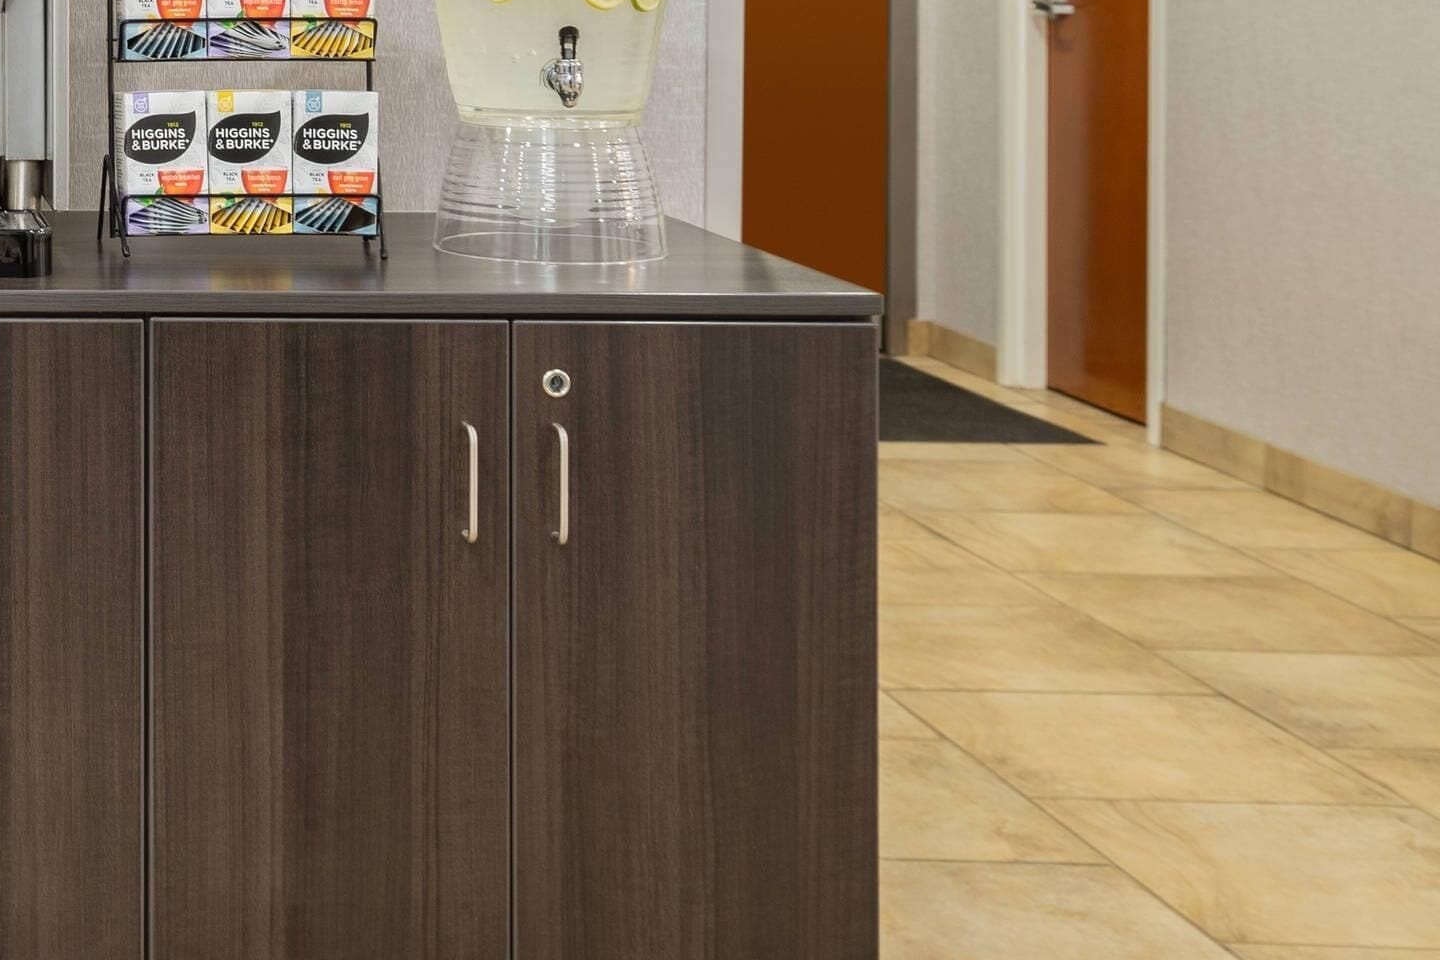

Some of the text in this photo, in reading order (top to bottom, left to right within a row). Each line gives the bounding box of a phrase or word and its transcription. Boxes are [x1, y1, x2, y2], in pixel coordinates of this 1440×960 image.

[132, 128, 185, 139] HIGGINS
[216, 128, 269, 138] HIGGINS
[304, 128, 357, 139] HIGGINS
